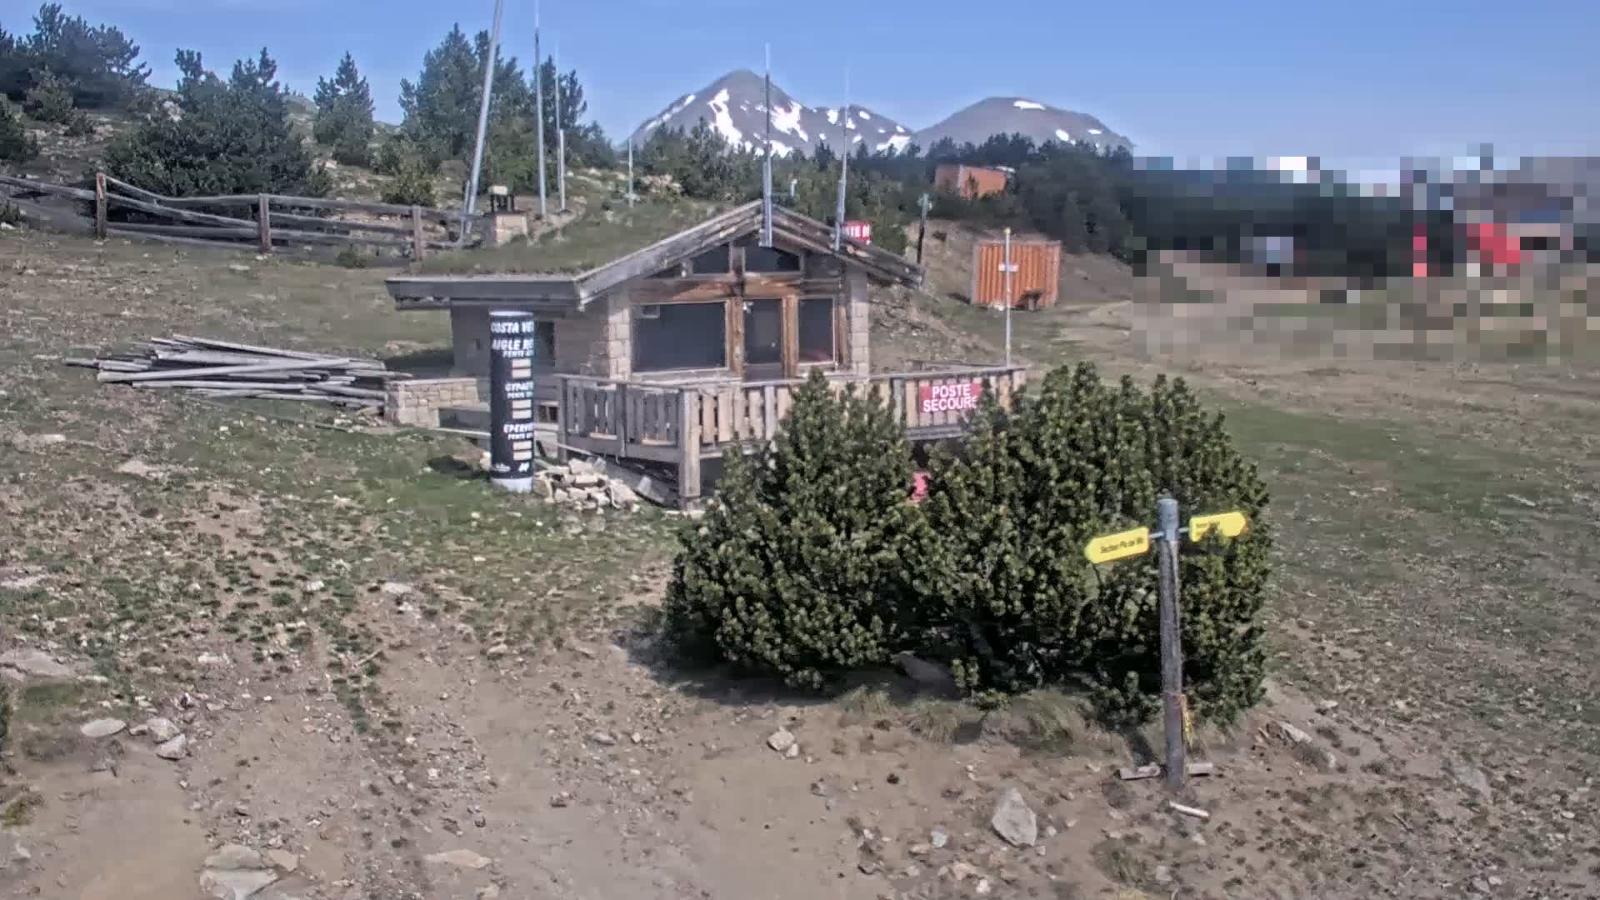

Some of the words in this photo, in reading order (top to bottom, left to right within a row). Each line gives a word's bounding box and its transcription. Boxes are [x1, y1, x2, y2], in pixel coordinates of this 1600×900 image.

[491, 322, 519, 333] COSTA
[492, 339, 521, 350] AIGLE
[932, 384, 971, 398] POSTE
